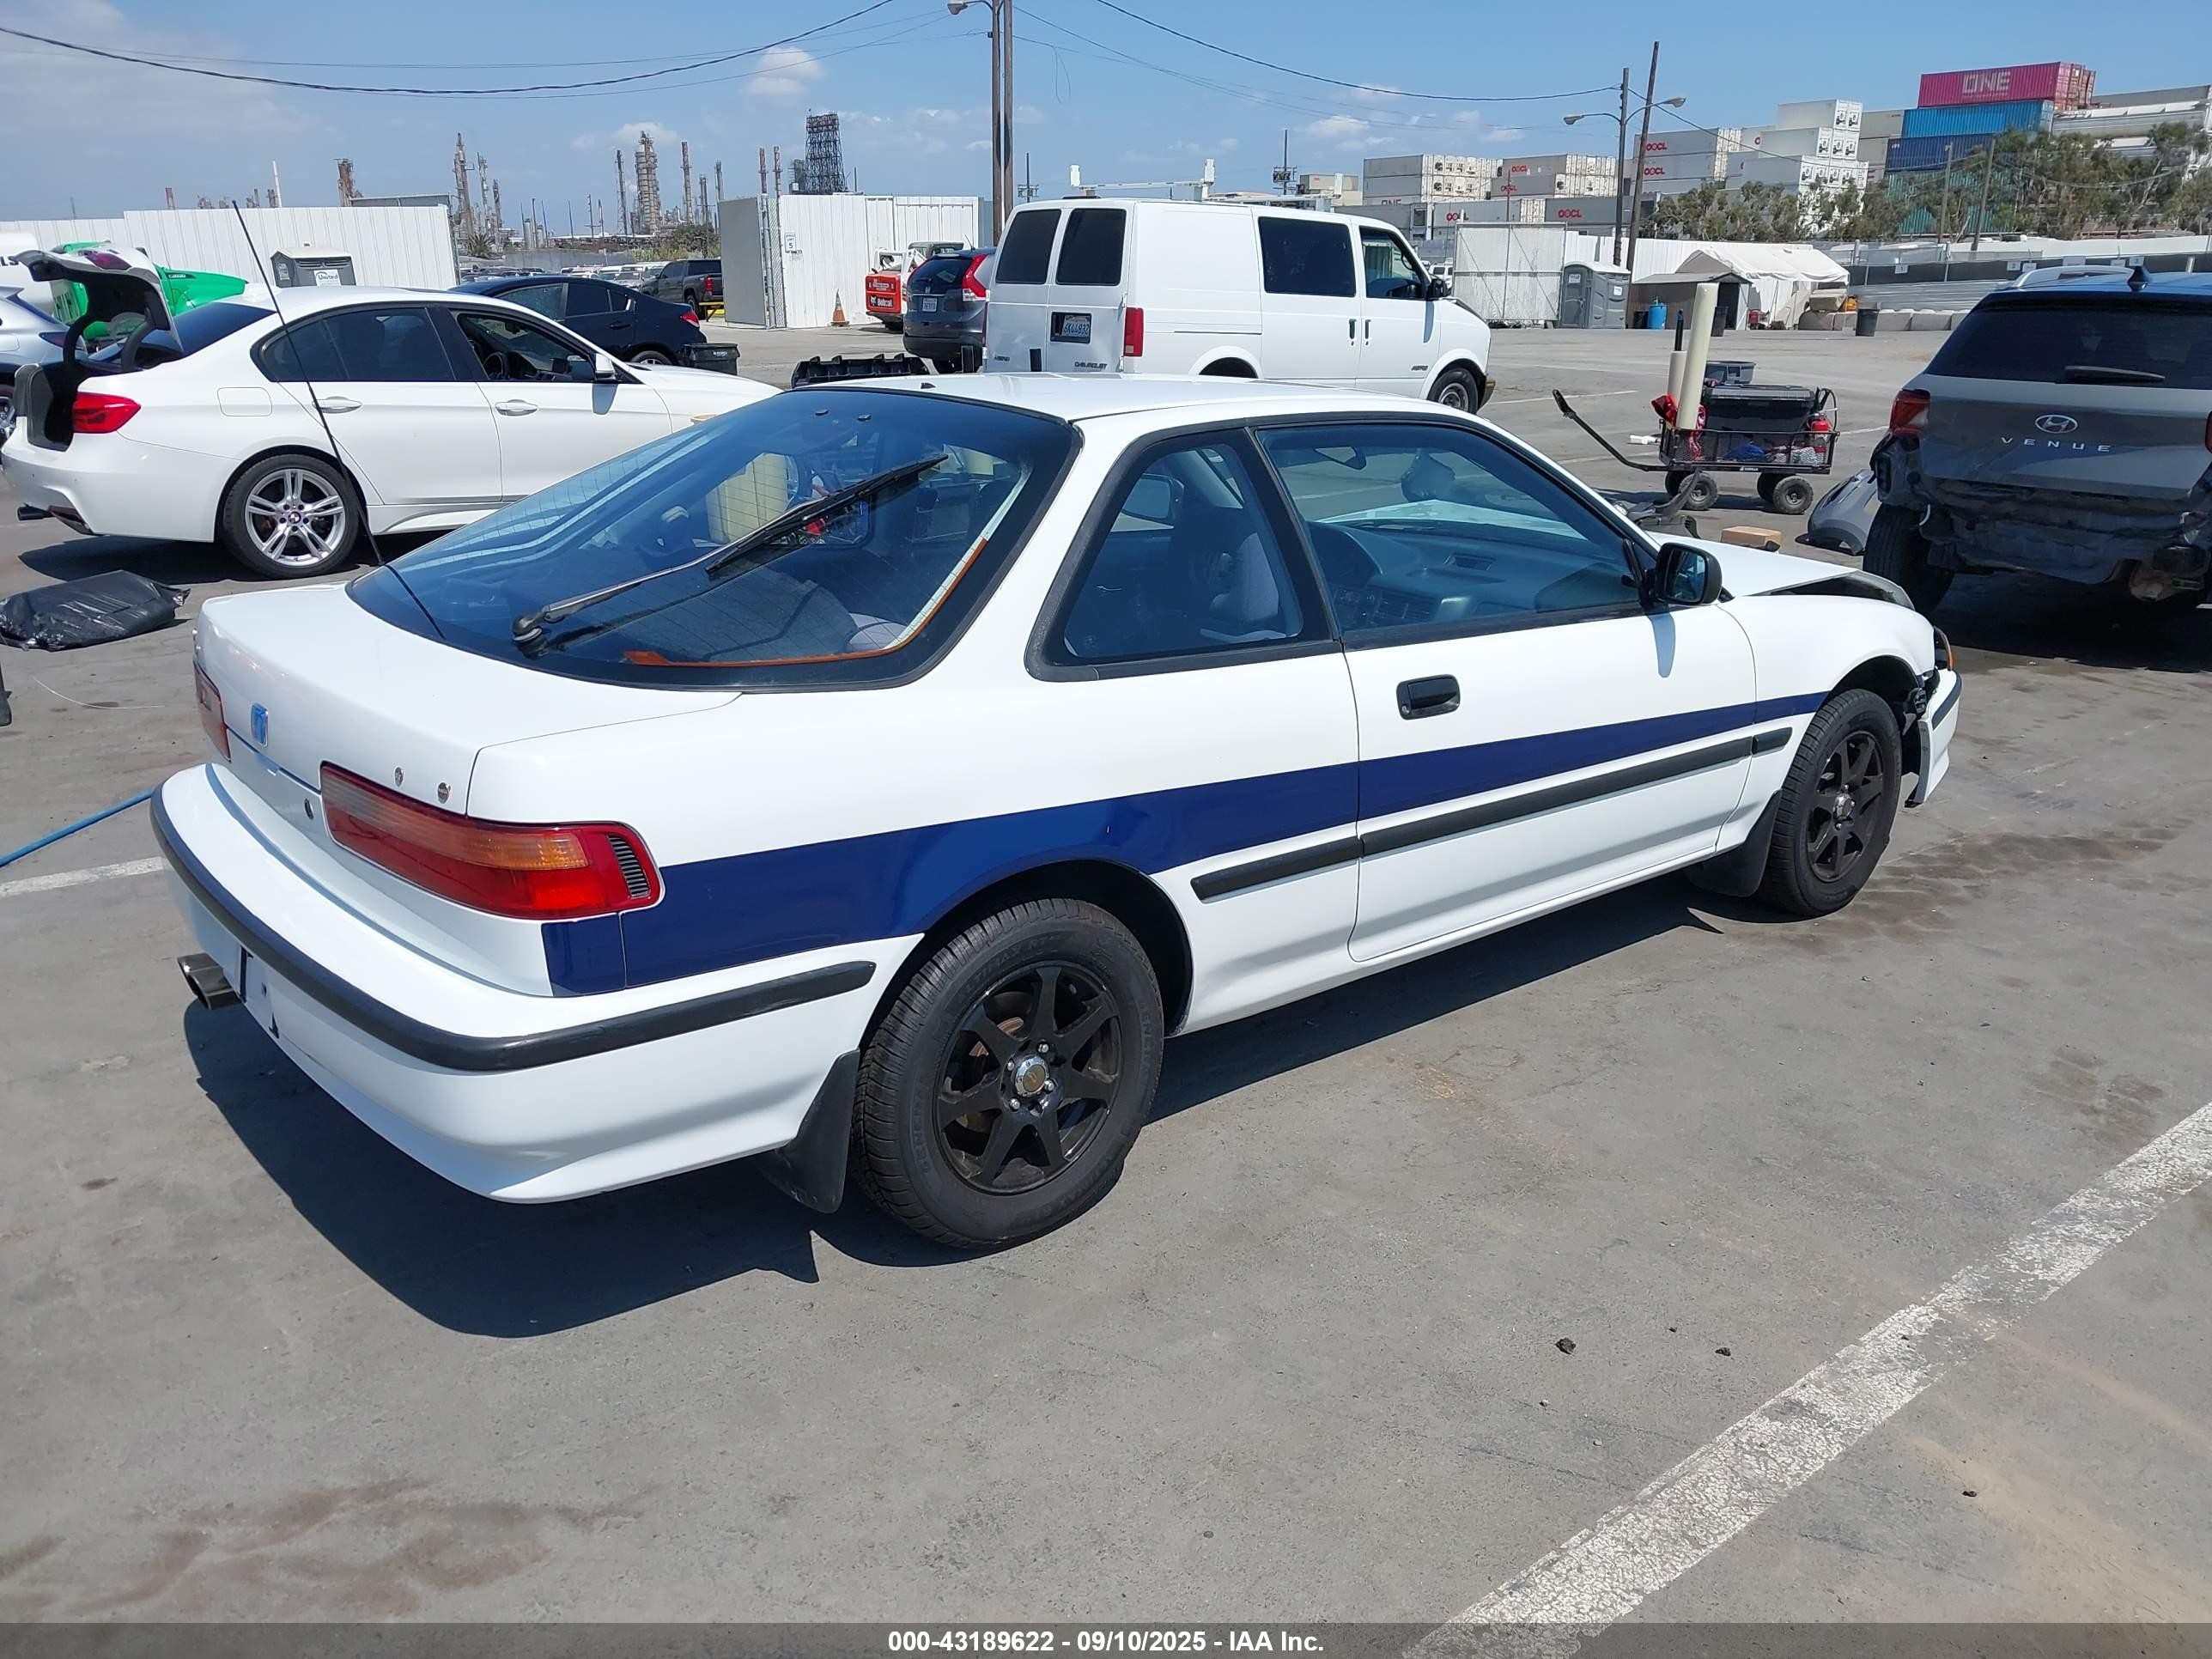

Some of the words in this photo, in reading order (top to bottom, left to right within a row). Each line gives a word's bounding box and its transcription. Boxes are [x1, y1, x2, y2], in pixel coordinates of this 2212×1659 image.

[1962, 71, 2010, 94] ONE
[1646, 143, 1667, 151] OOCL
[1558, 209, 1582, 218] OOCL
[2001, 436, 2112, 452] VENUE
